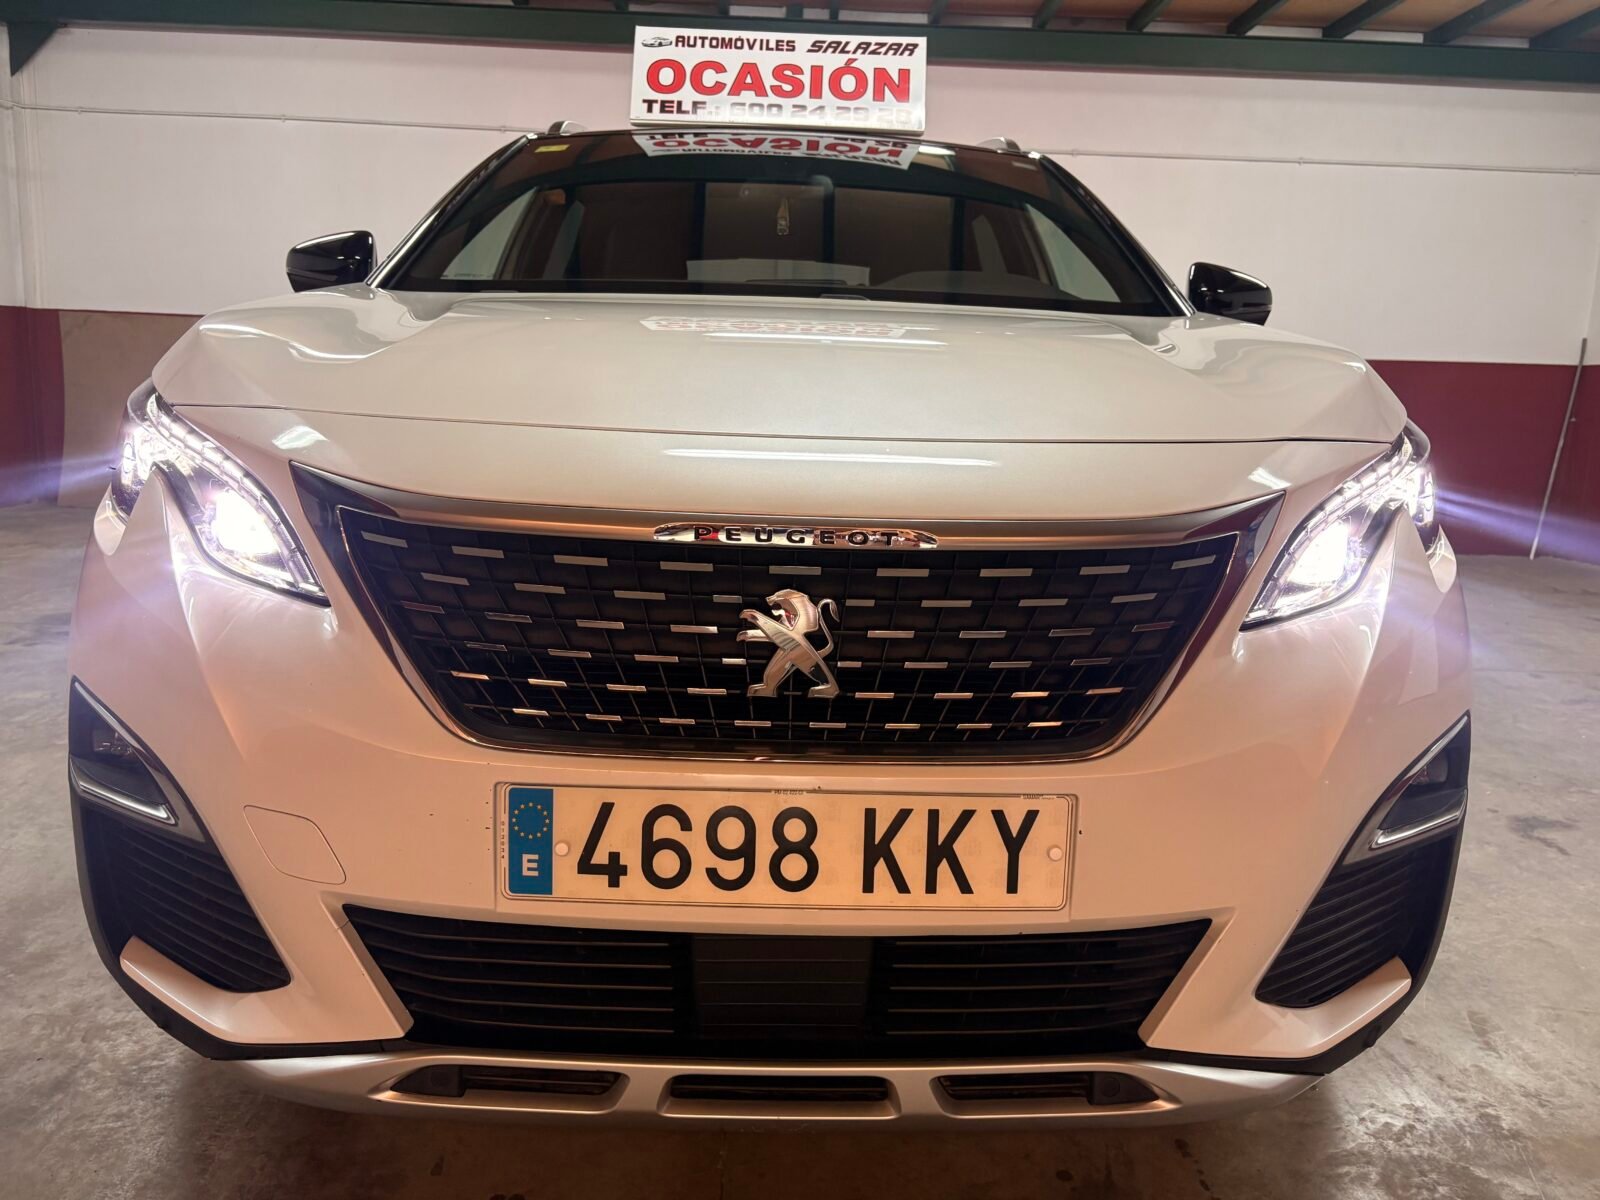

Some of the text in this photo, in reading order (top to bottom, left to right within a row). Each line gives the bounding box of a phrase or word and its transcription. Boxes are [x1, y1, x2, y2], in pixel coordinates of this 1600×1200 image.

[674, 35, 919, 57] AUTOMÓVILES SALAZAR
[646, 58, 911, 103] OCASIÓN
[730, 102, 783, 118] 600
[790, 104, 826, 120] 24
[694, 526, 899, 546] PEUGEOT
[577, 801, 1040, 895] 4698 KKY
[521, 853, 540, 877] E
